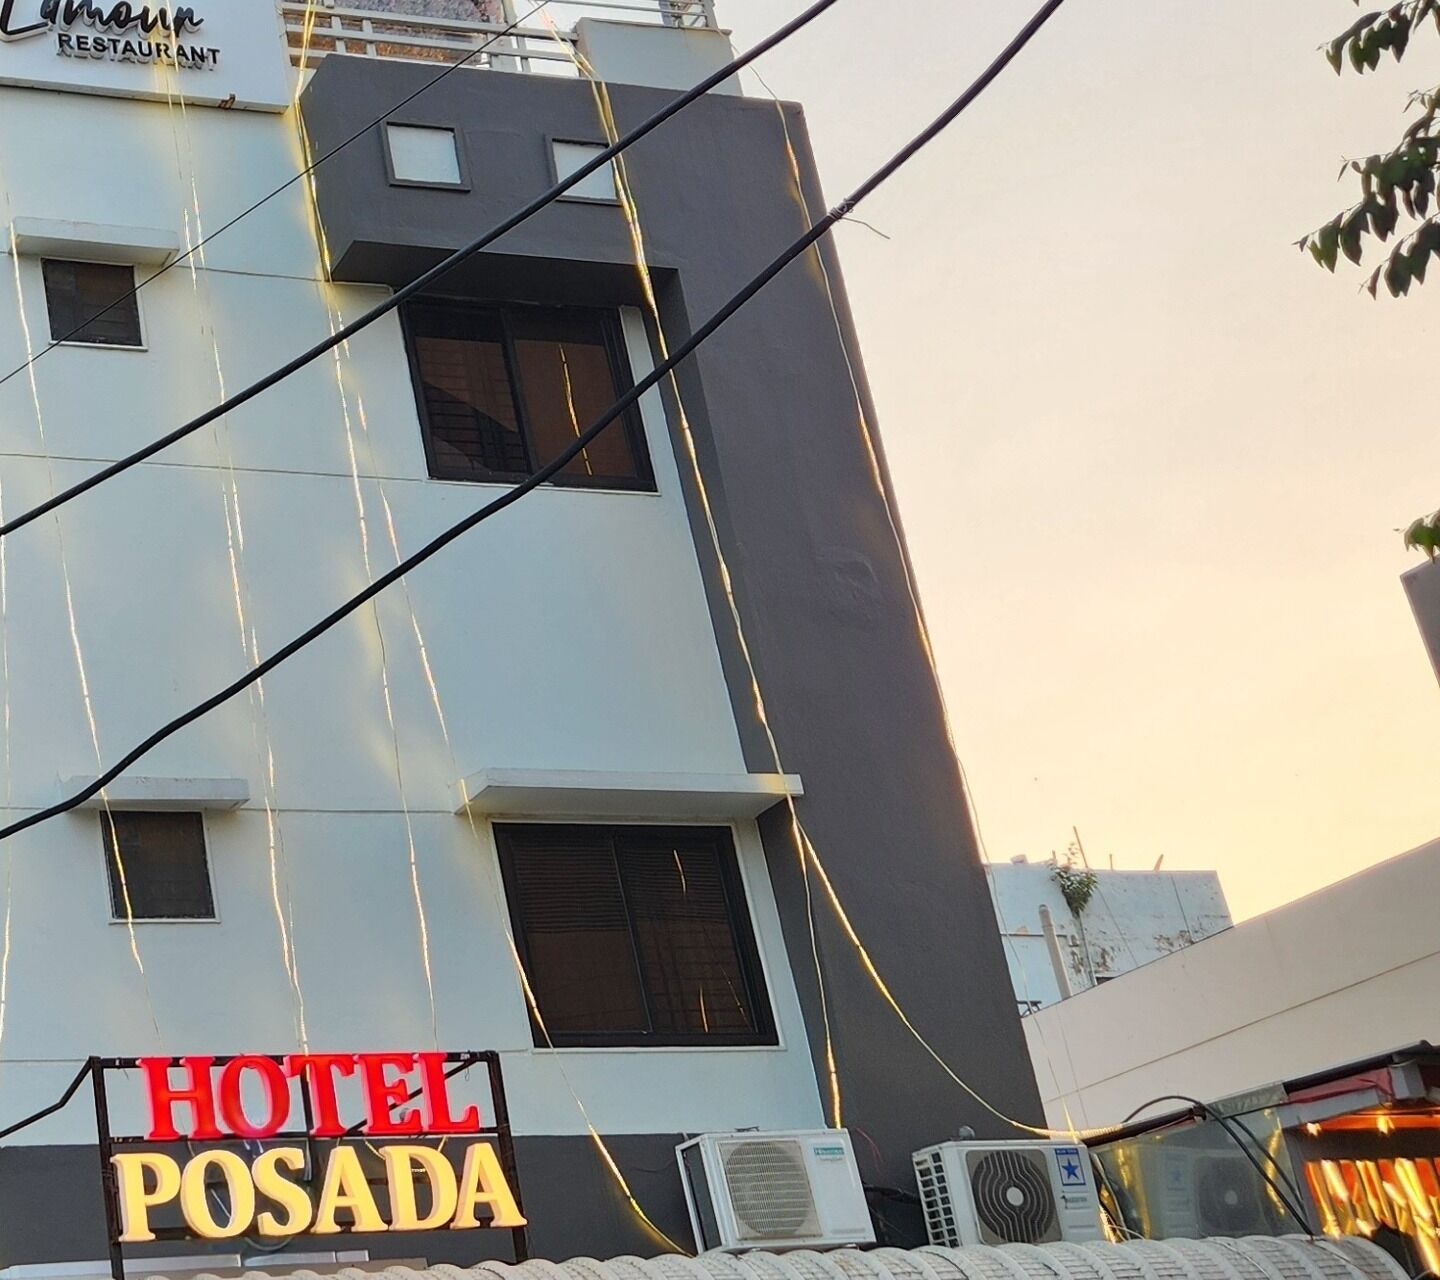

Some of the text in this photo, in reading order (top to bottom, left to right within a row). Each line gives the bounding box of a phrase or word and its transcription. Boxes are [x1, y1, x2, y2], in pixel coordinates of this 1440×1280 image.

[57, 32, 220, 68] RESTAURANT
[136, 1052, 481, 1141] HOTEL
[110, 1142, 527, 1243] POSADA
